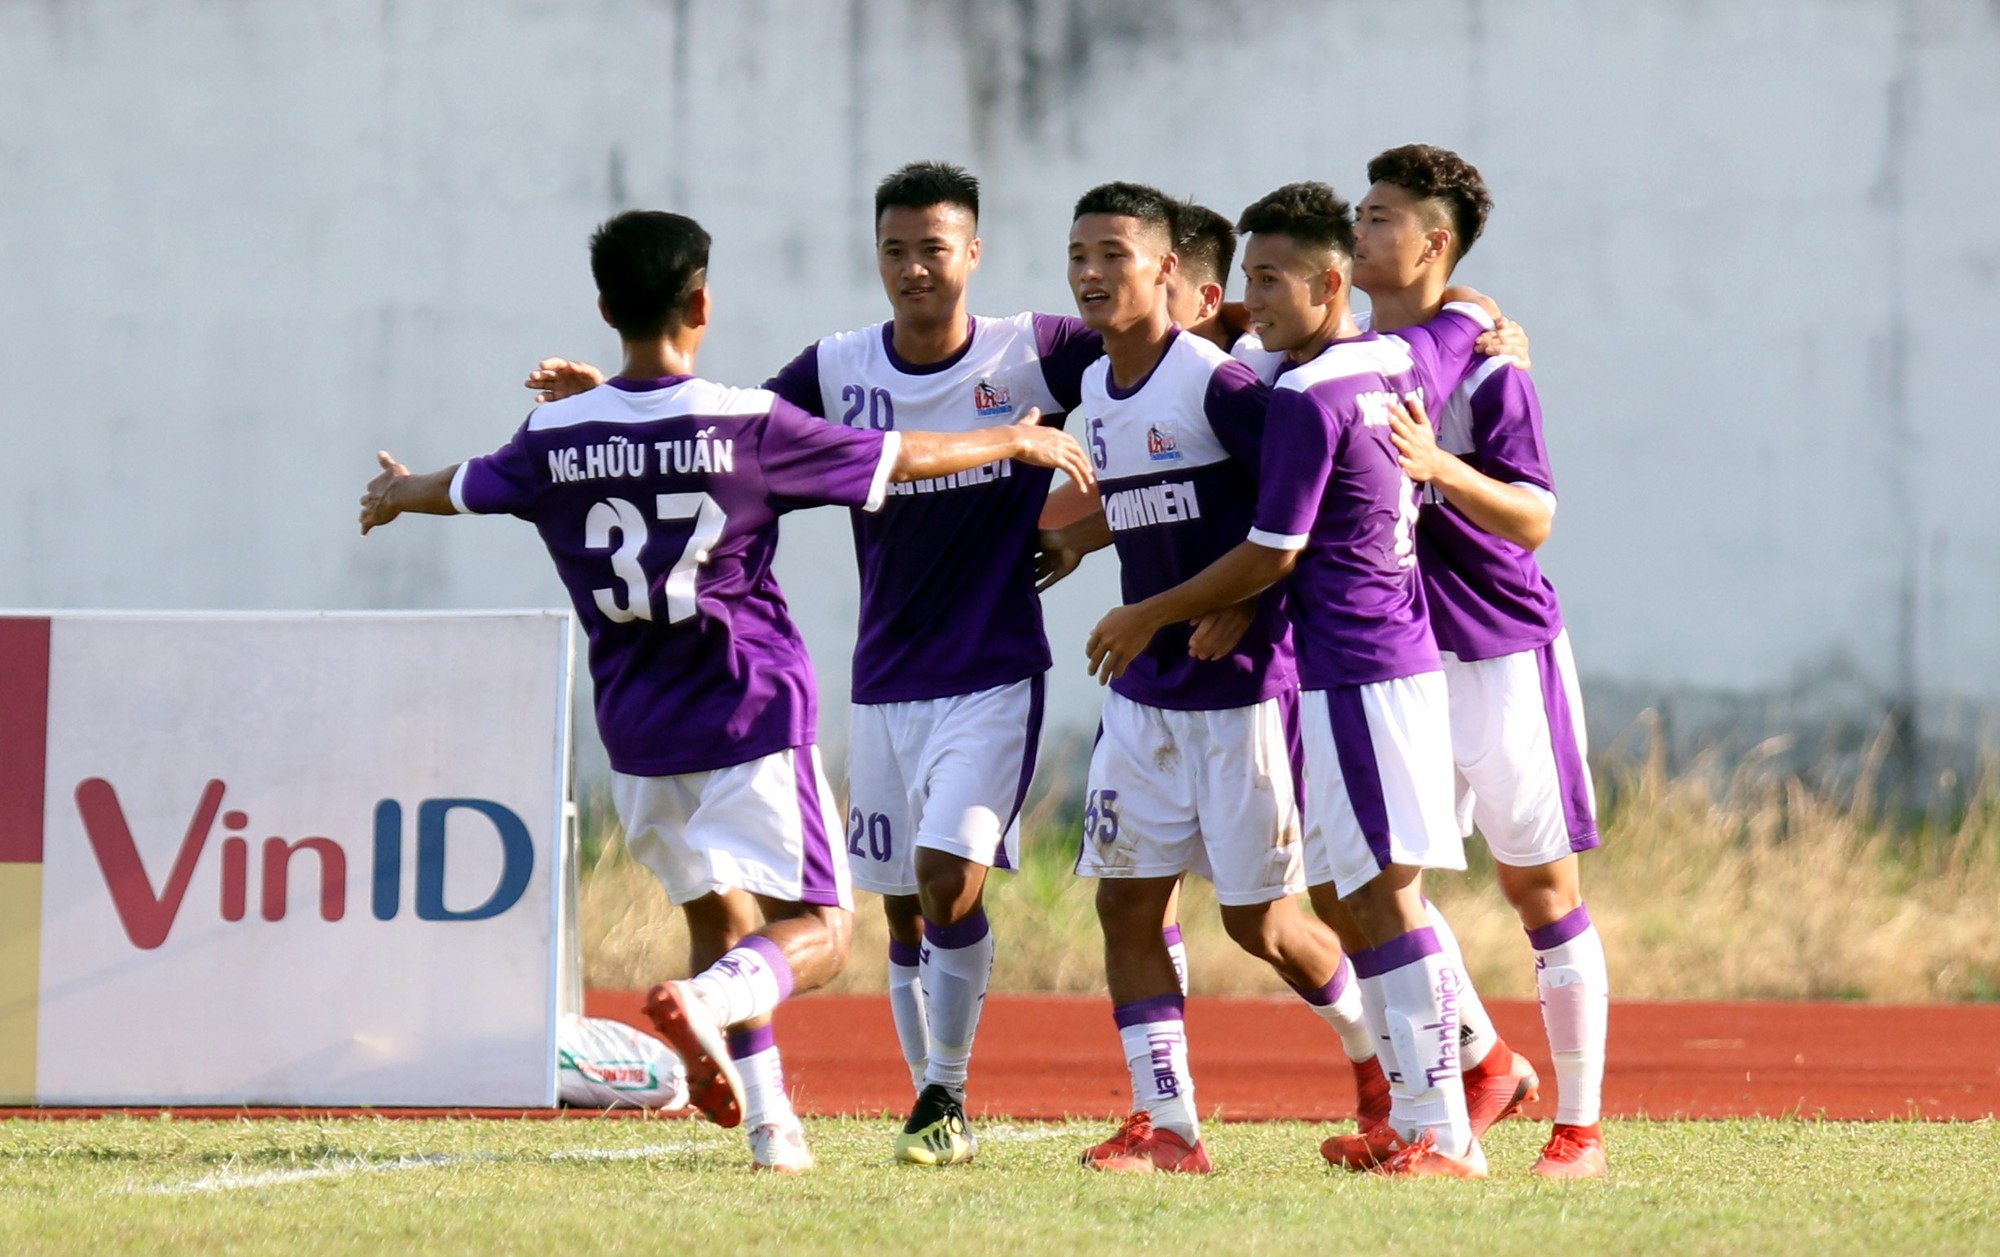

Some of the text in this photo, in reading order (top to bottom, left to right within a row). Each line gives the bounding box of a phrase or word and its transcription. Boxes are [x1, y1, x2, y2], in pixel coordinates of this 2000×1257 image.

[842, 385, 894, 430] 20
[548, 426, 734, 483] NG.HỮU TUẤN
[1086, 418, 1107, 471] 5
[585, 492, 727, 624] 37
[850, 806, 892, 863] 20
[75, 777, 534, 950] VinID
